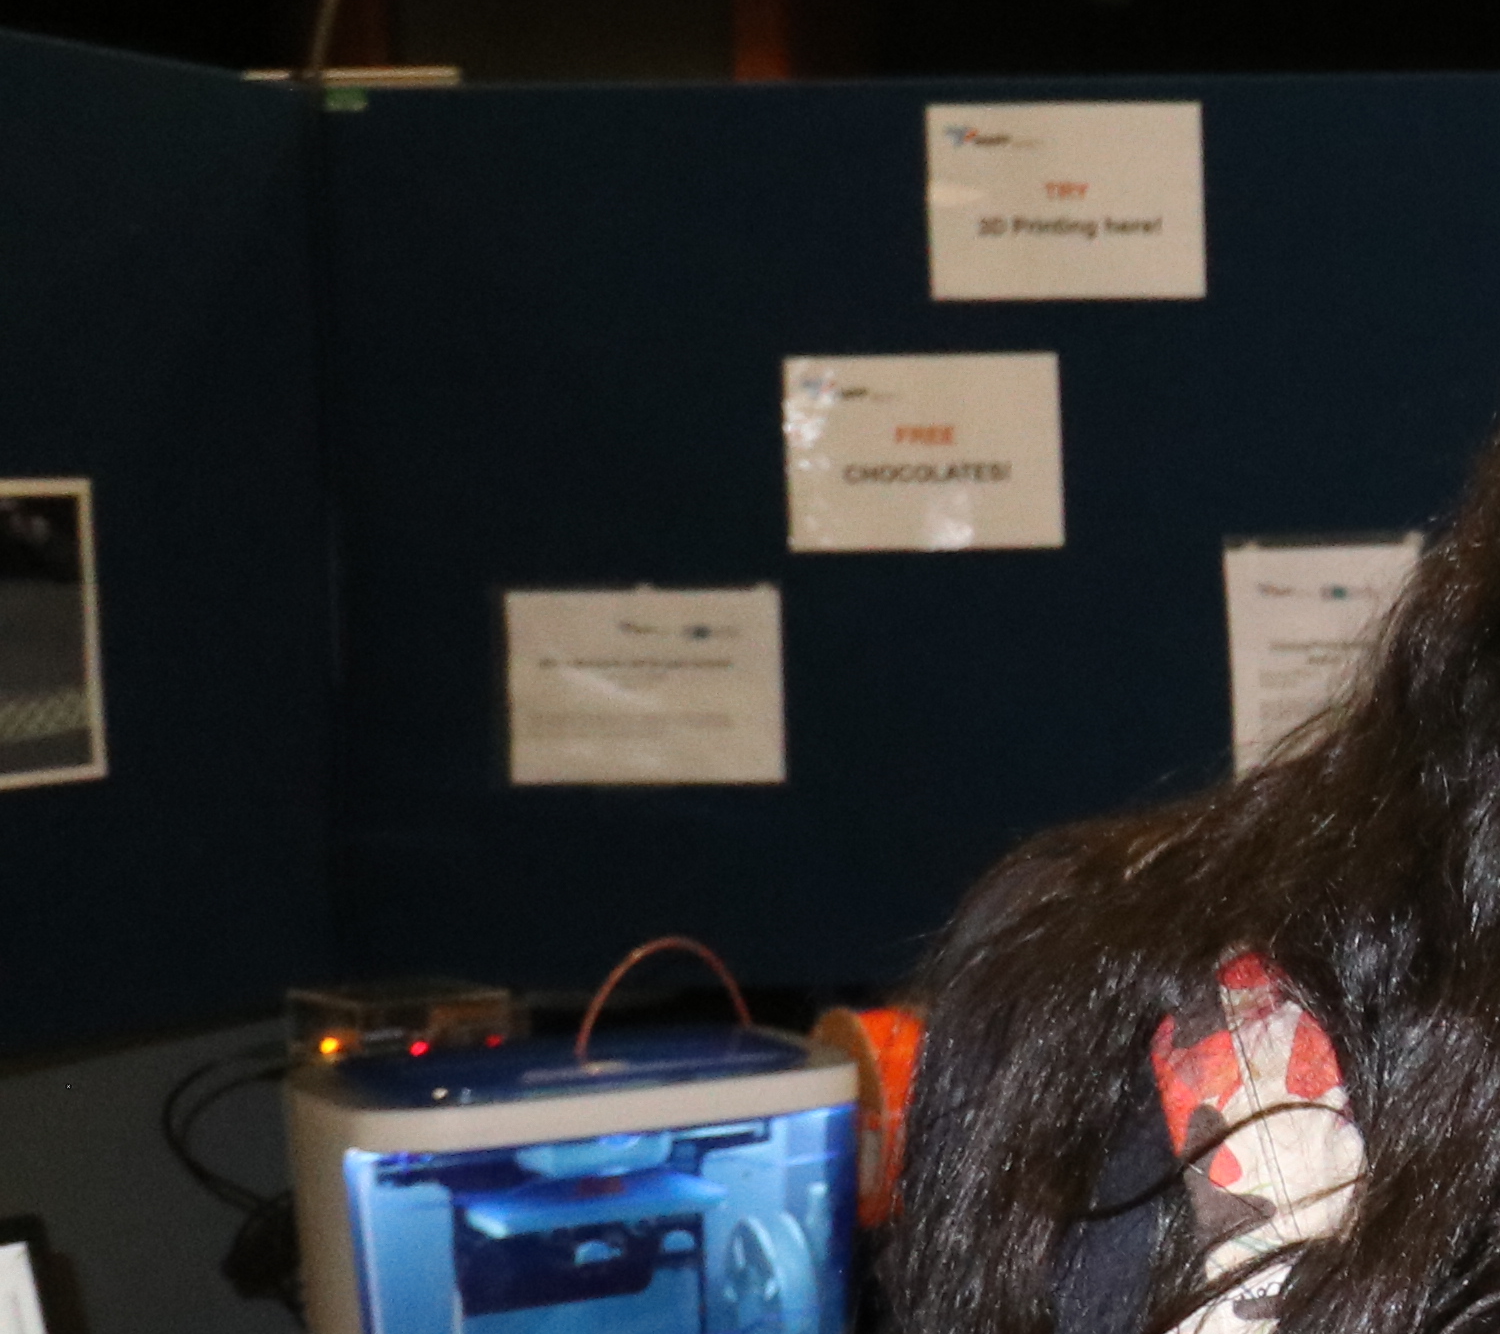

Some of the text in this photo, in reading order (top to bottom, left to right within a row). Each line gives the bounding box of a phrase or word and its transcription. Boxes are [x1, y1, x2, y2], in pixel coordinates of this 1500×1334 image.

[1045, 181, 1089, 200] TRY
[1012, 216, 1099, 240] Printing
[1104, 216, 1163, 234] here!
[895, 425, 956, 445] FREE
[842, 462, 1012, 484] CHOCOLATES!
